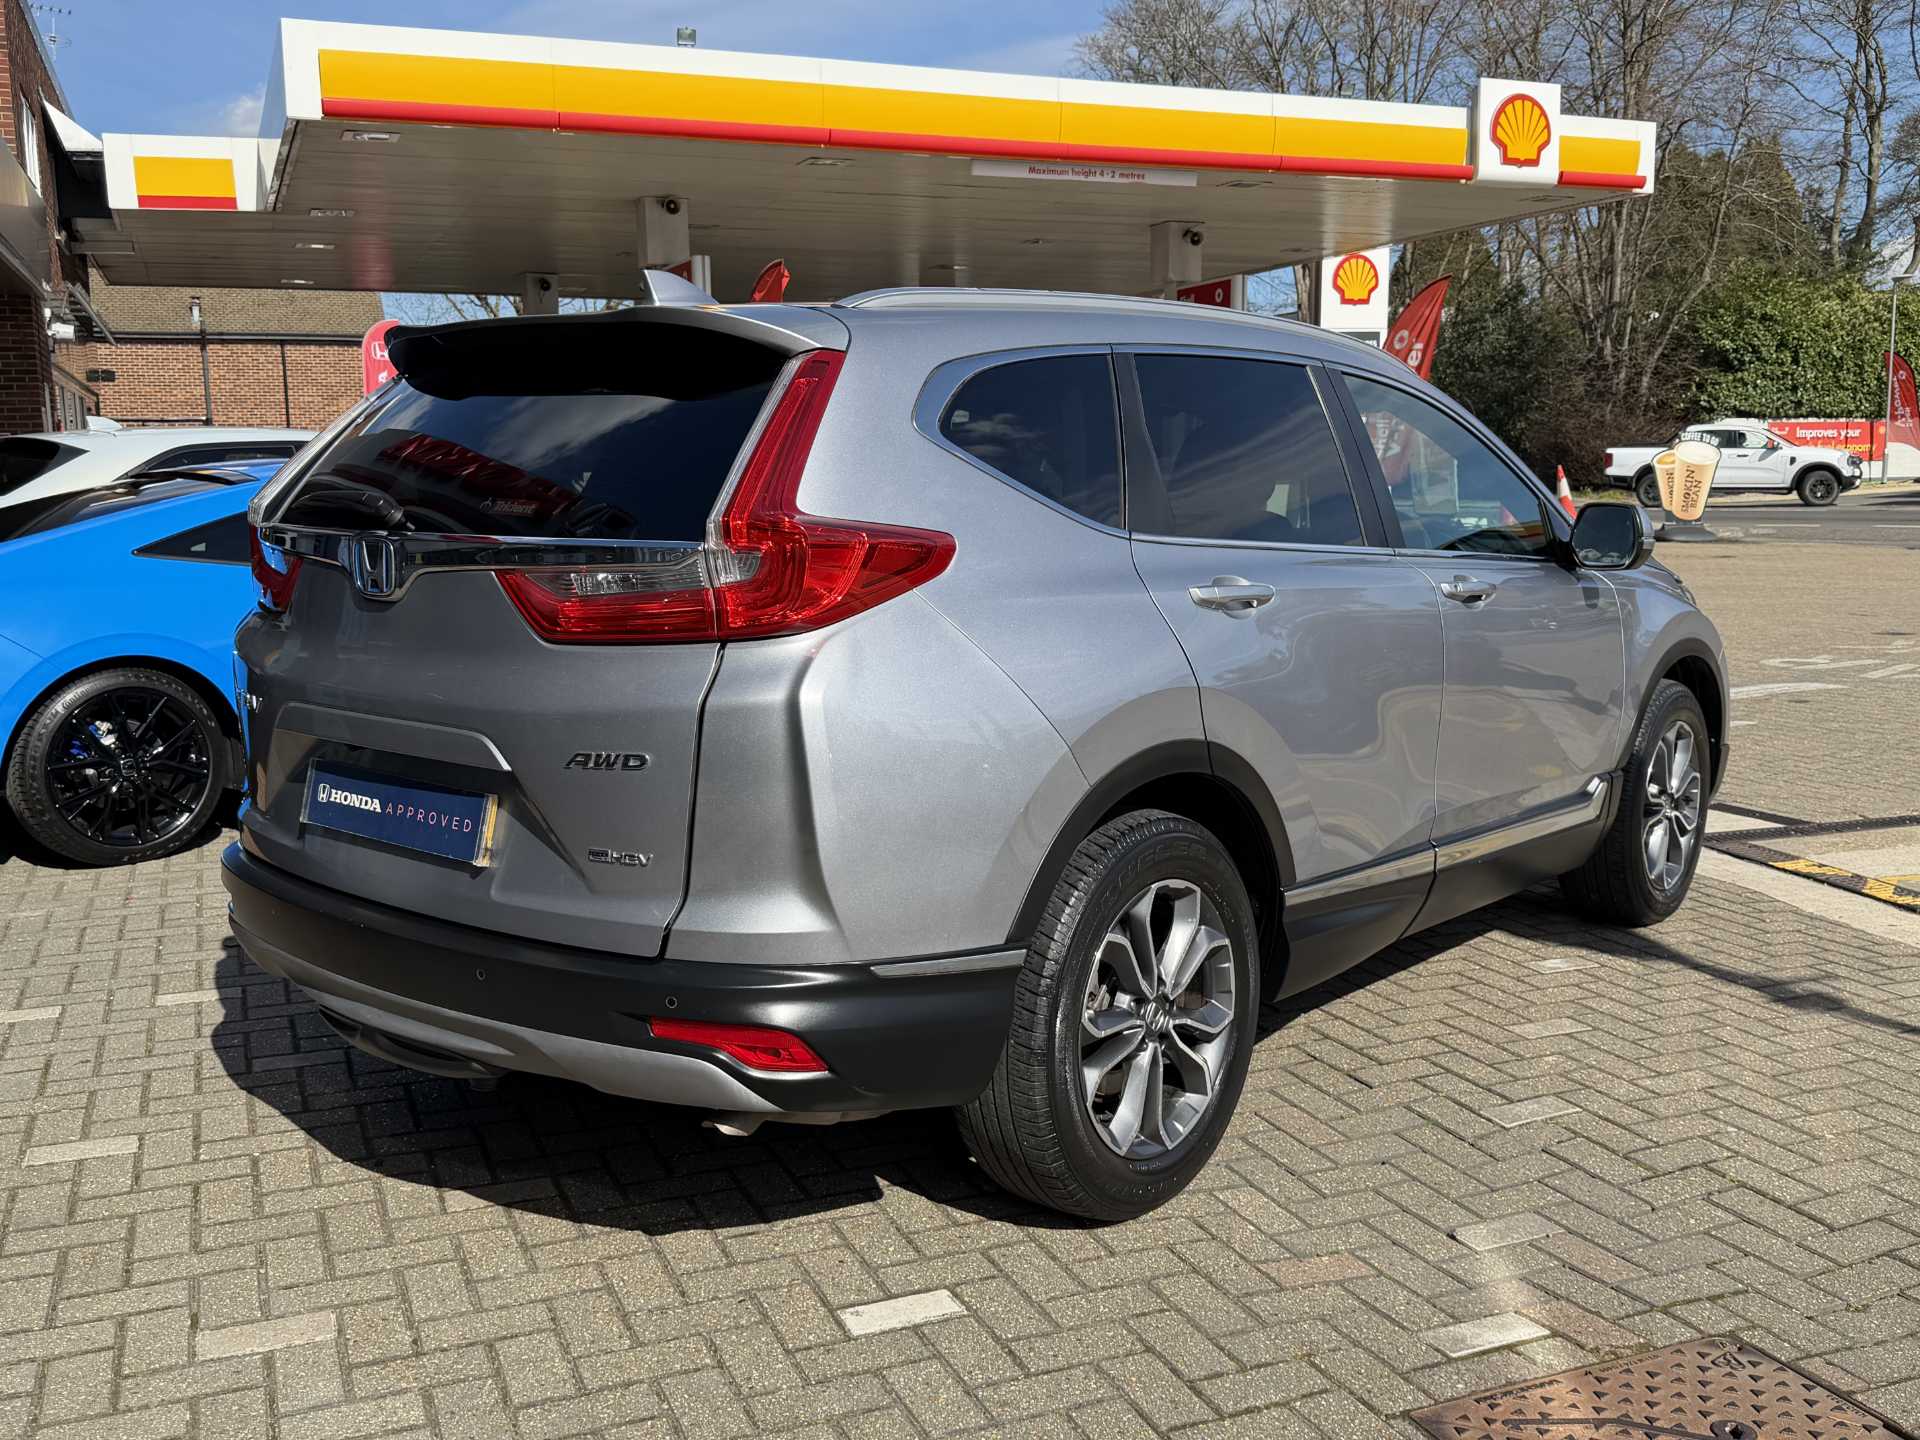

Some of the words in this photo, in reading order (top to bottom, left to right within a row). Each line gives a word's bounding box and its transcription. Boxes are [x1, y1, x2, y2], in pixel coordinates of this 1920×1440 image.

[1028, 165, 1070, 177] Maximum
[1071, 167, 1098, 179] height
[1118, 171, 1146, 181] metres
[1796, 426, 1838, 440] Improves
[1839, 427, 1862, 439] your
[562, 750, 652, 772] AWD
[329, 788, 382, 813] HONDA
[385, 802, 472, 832] APPROVED
